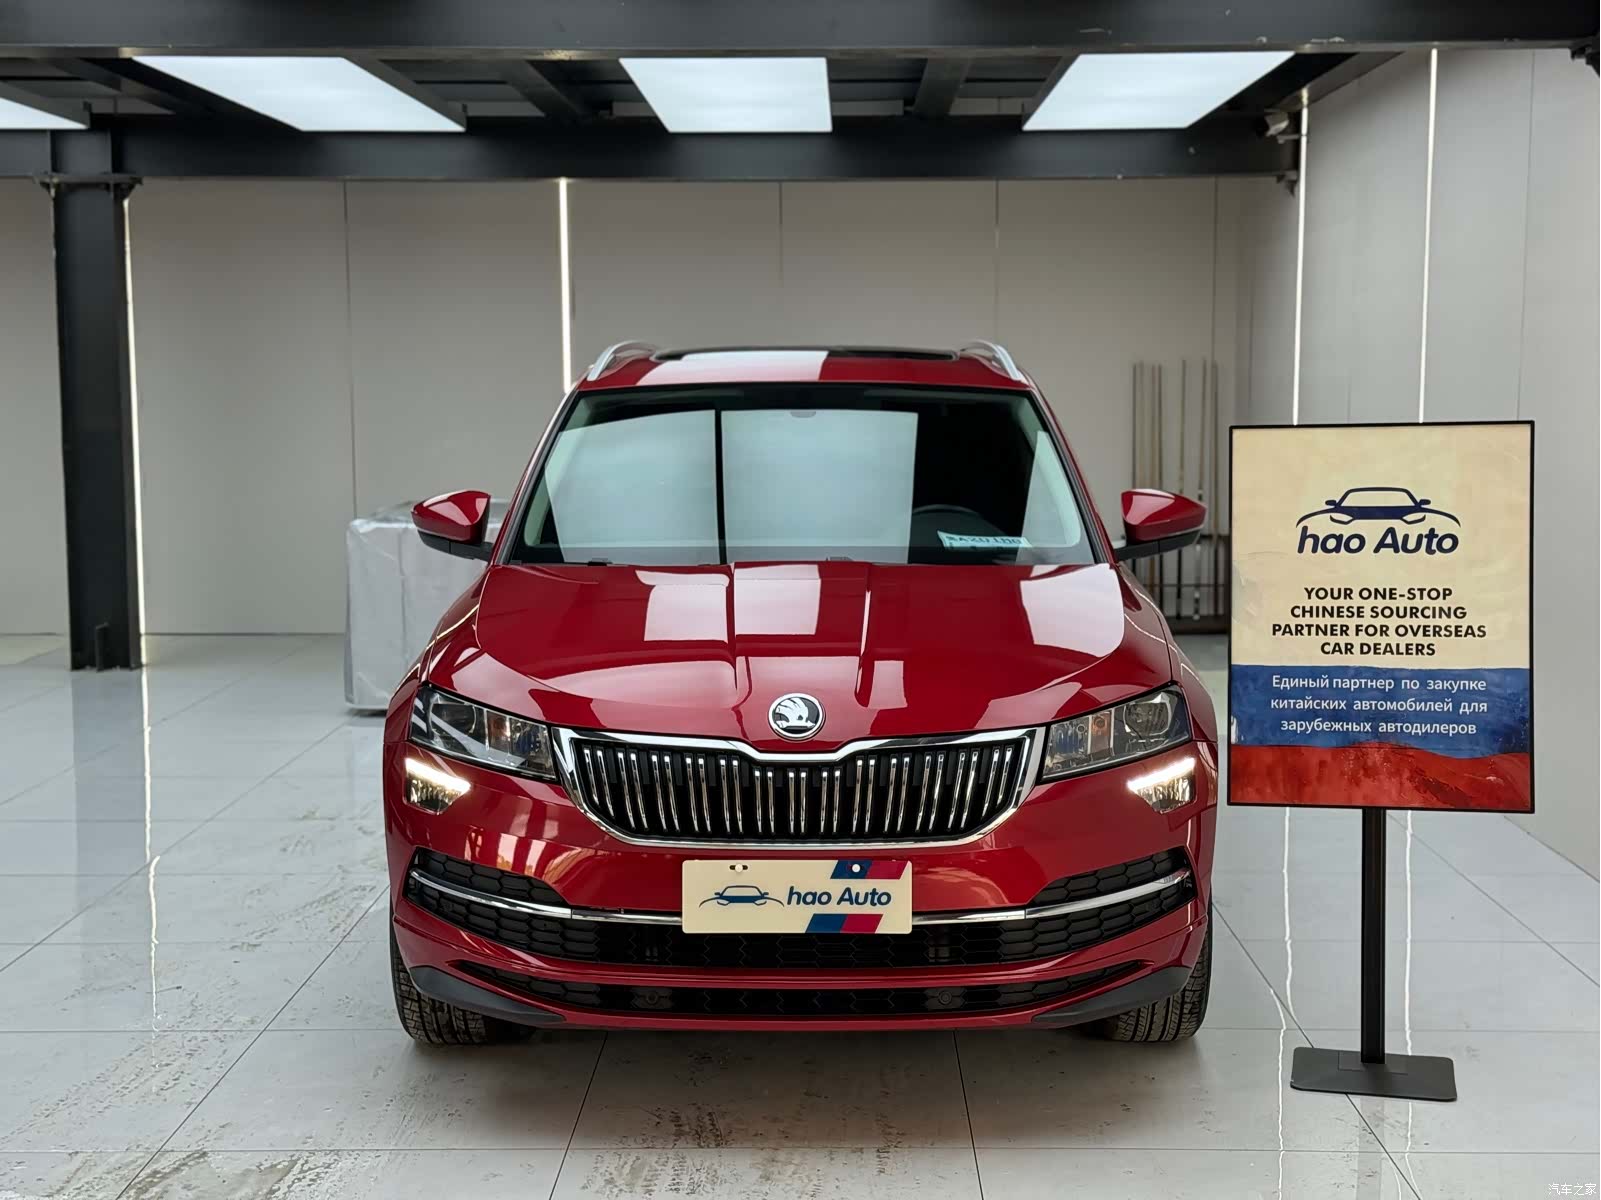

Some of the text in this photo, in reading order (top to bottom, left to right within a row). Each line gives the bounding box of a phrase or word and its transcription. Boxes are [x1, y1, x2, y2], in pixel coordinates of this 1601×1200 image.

[1297, 526, 1459, 555] hao Auto
[1304, 587, 1453, 600] YOUR ONE-STOP
[1290, 605, 1468, 620] CHINESE SOURCING
[1272, 624, 1486, 638] PARTNER FOR OVERSEAS
[1320, 642, 1436, 656] CAR DEALERS
[1272, 675, 1486, 693] Единый партнер по закупке
[1270, 696, 1488, 714] китайских автомобилей для
[1280, 718, 1476, 736] зарубежных автодилеров
[787, 886, 891, 906] hao Auto
